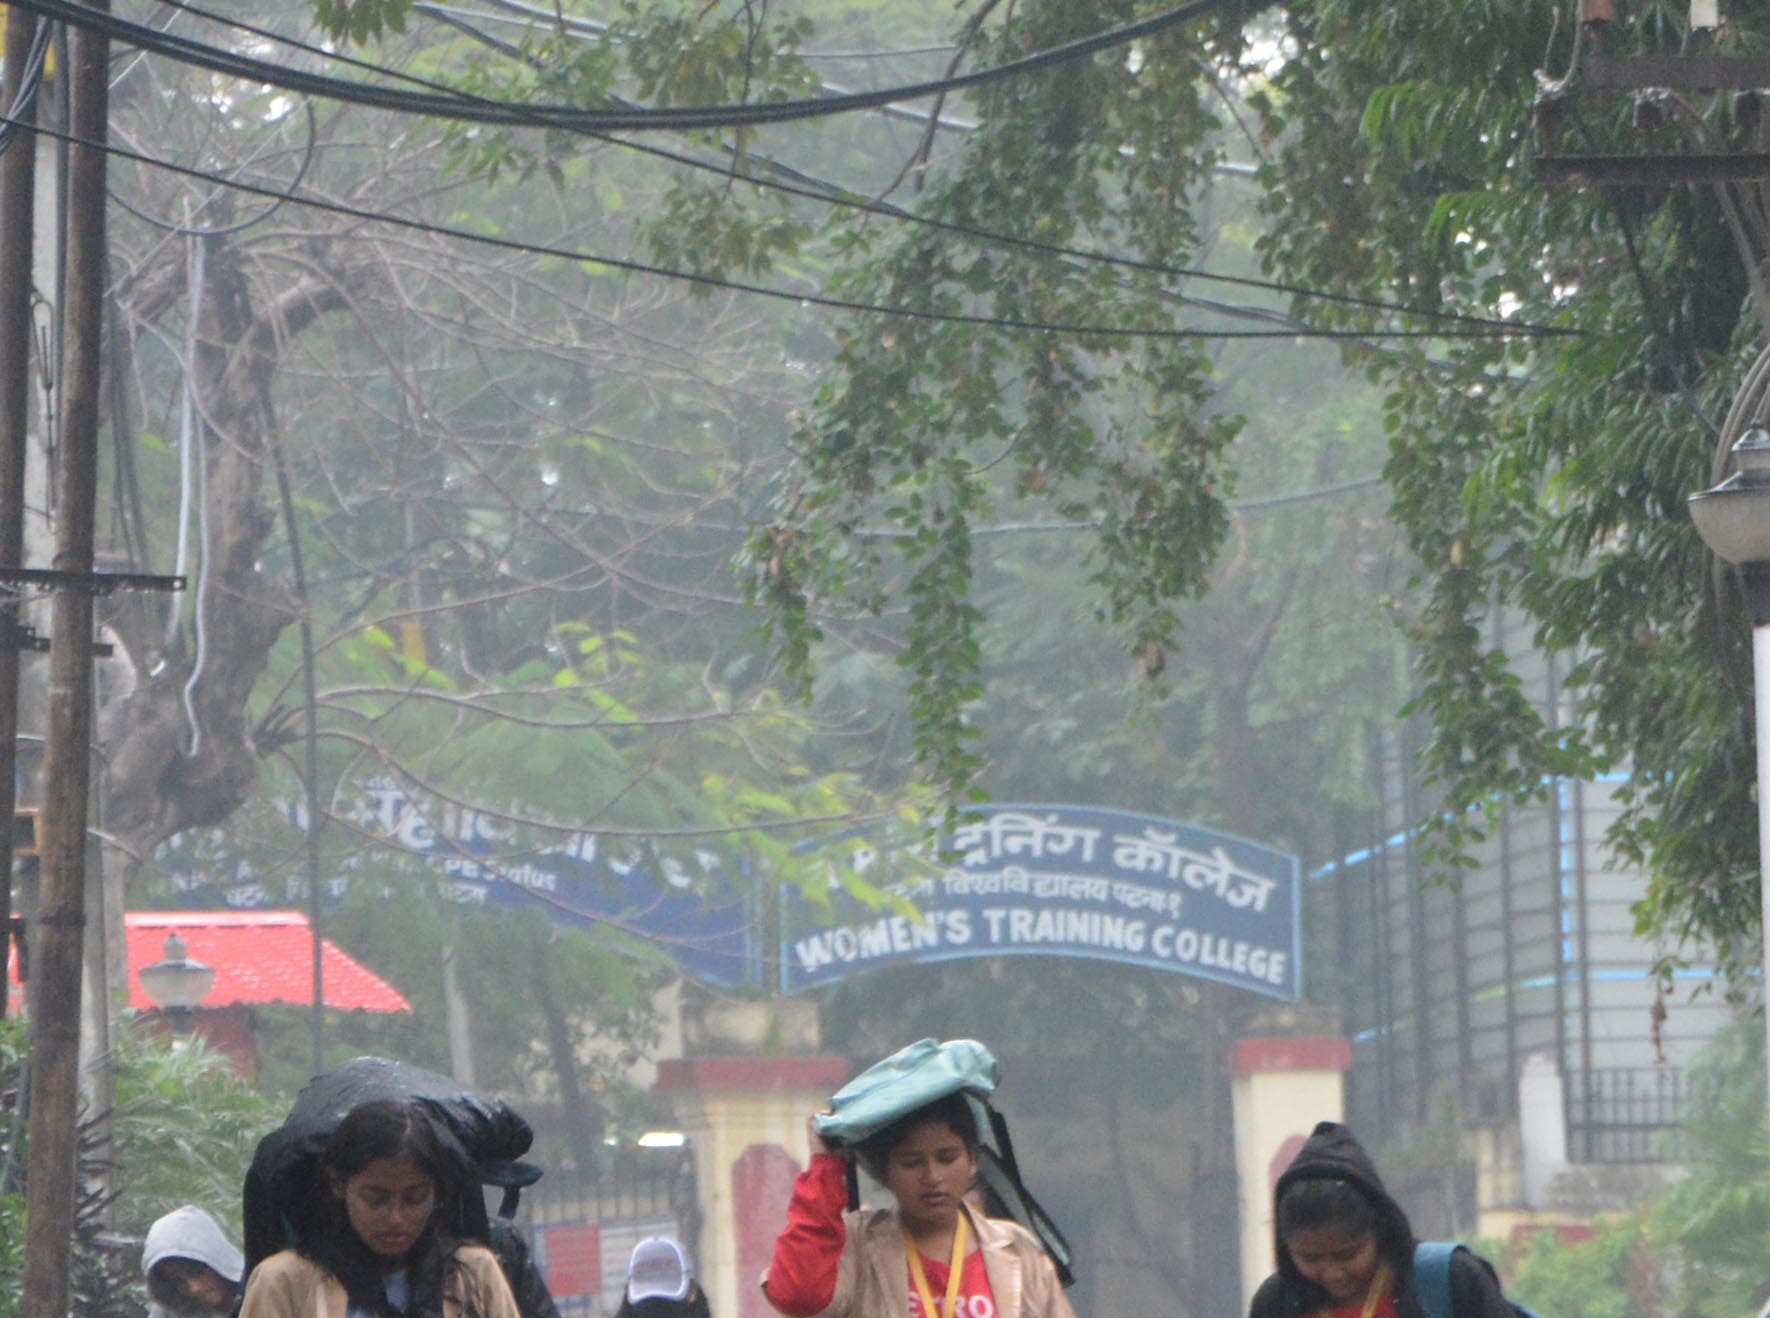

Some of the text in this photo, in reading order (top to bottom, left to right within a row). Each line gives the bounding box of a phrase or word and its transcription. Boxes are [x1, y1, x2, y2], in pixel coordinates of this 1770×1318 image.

[1113, 827, 1277, 912] कॉलेज
[795, 908, 1287, 985] WOMEN'S TRAINING COLLEGE
